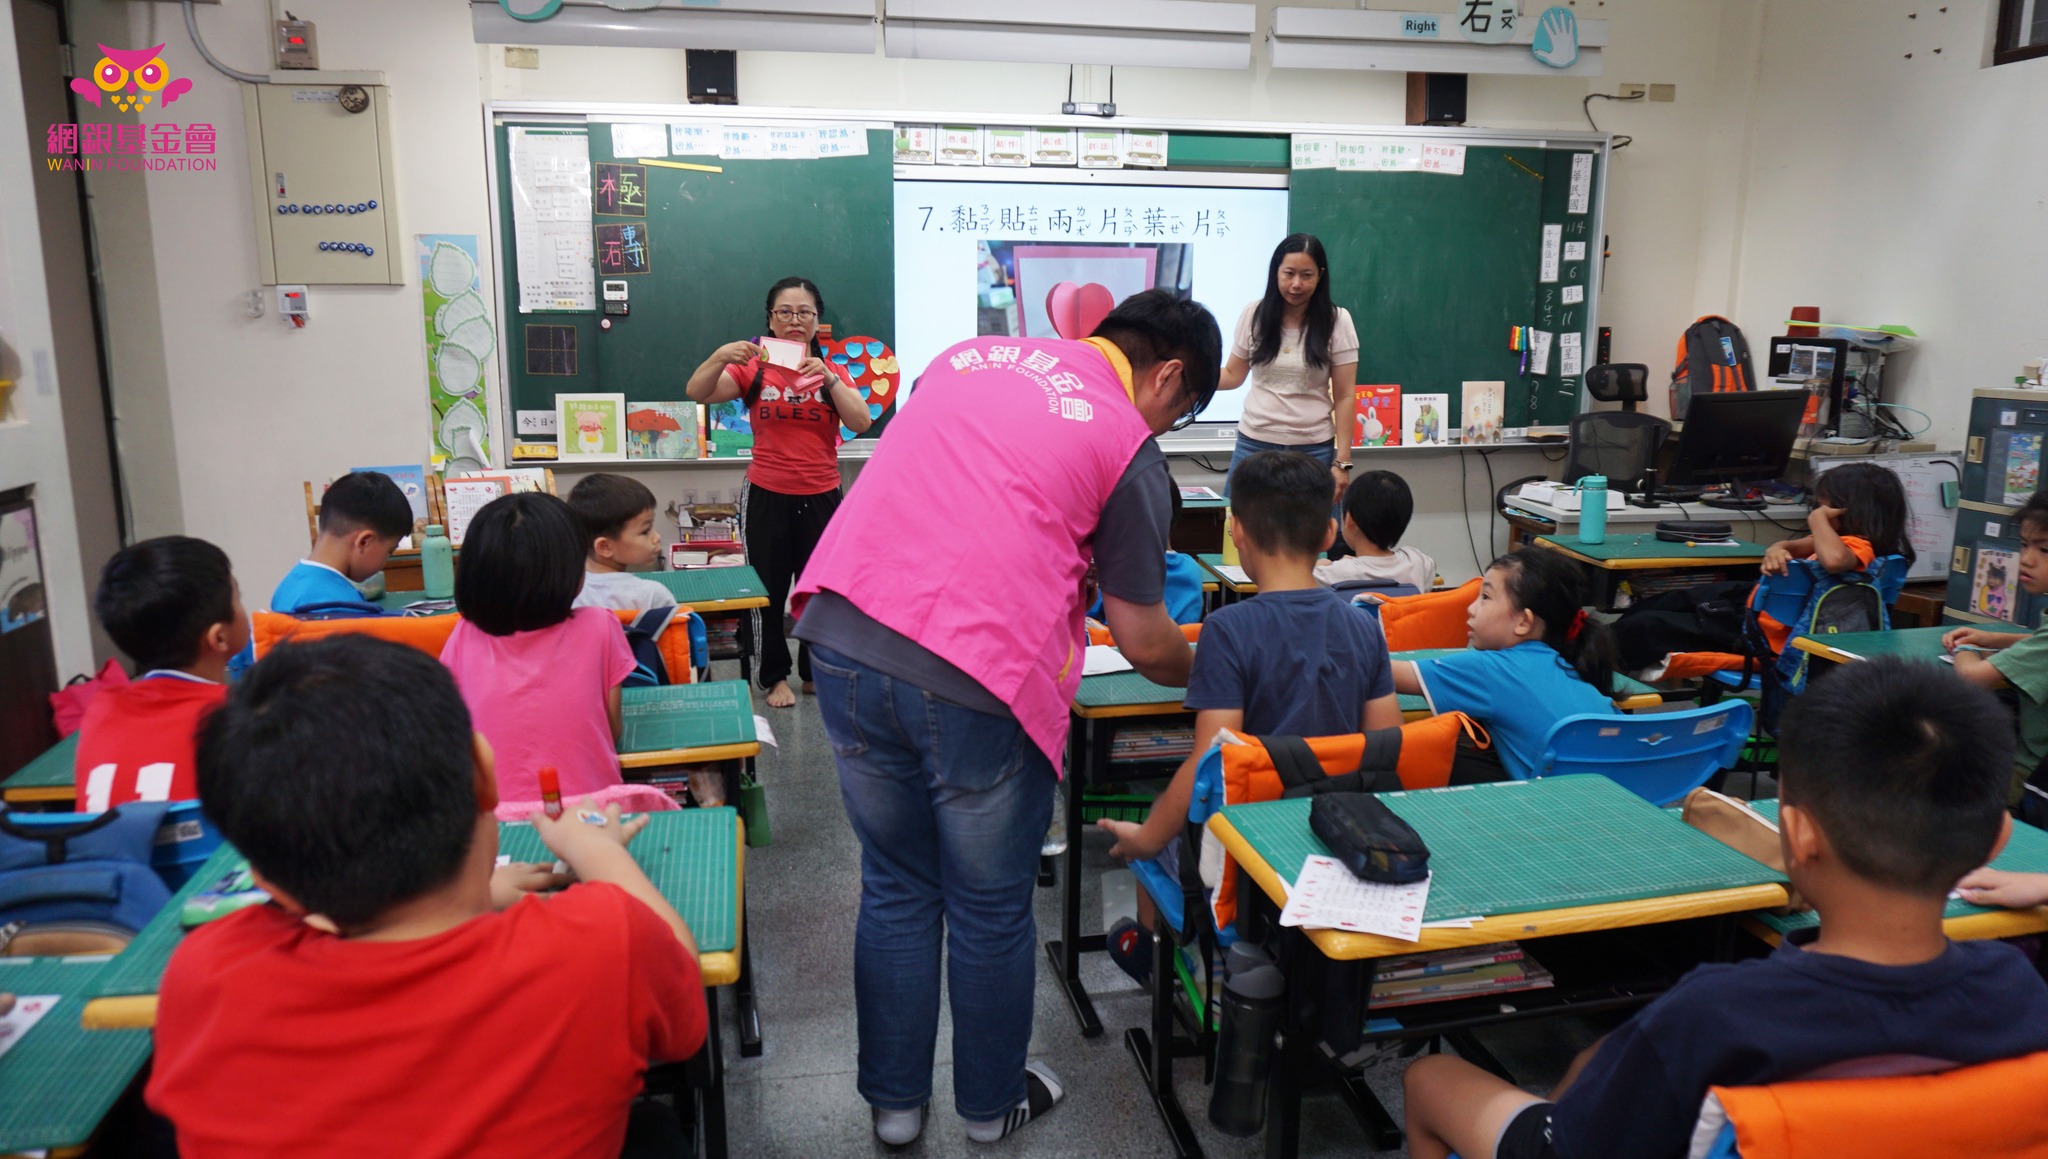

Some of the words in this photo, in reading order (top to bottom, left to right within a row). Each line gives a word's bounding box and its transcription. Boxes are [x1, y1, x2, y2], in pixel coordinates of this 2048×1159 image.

[1461, 0, 1493, 33] 右
[1405, 20, 1437, 33] Right
[1569, 155, 1583, 211] 中華民國
[1567, 220, 1585, 234] 114
[1566, 244, 1577, 256] 年
[1569, 266, 1577, 278] 6
[1566, 288, 1573, 300] 月
[1562, 311, 1573, 326] 11
[949, 345, 1094, 422] 網銀基金會
[1007, 364, 1060, 415] FOUNDATION
[760, 406, 835, 424] BLEST
[85, 763, 175, 813] 11
